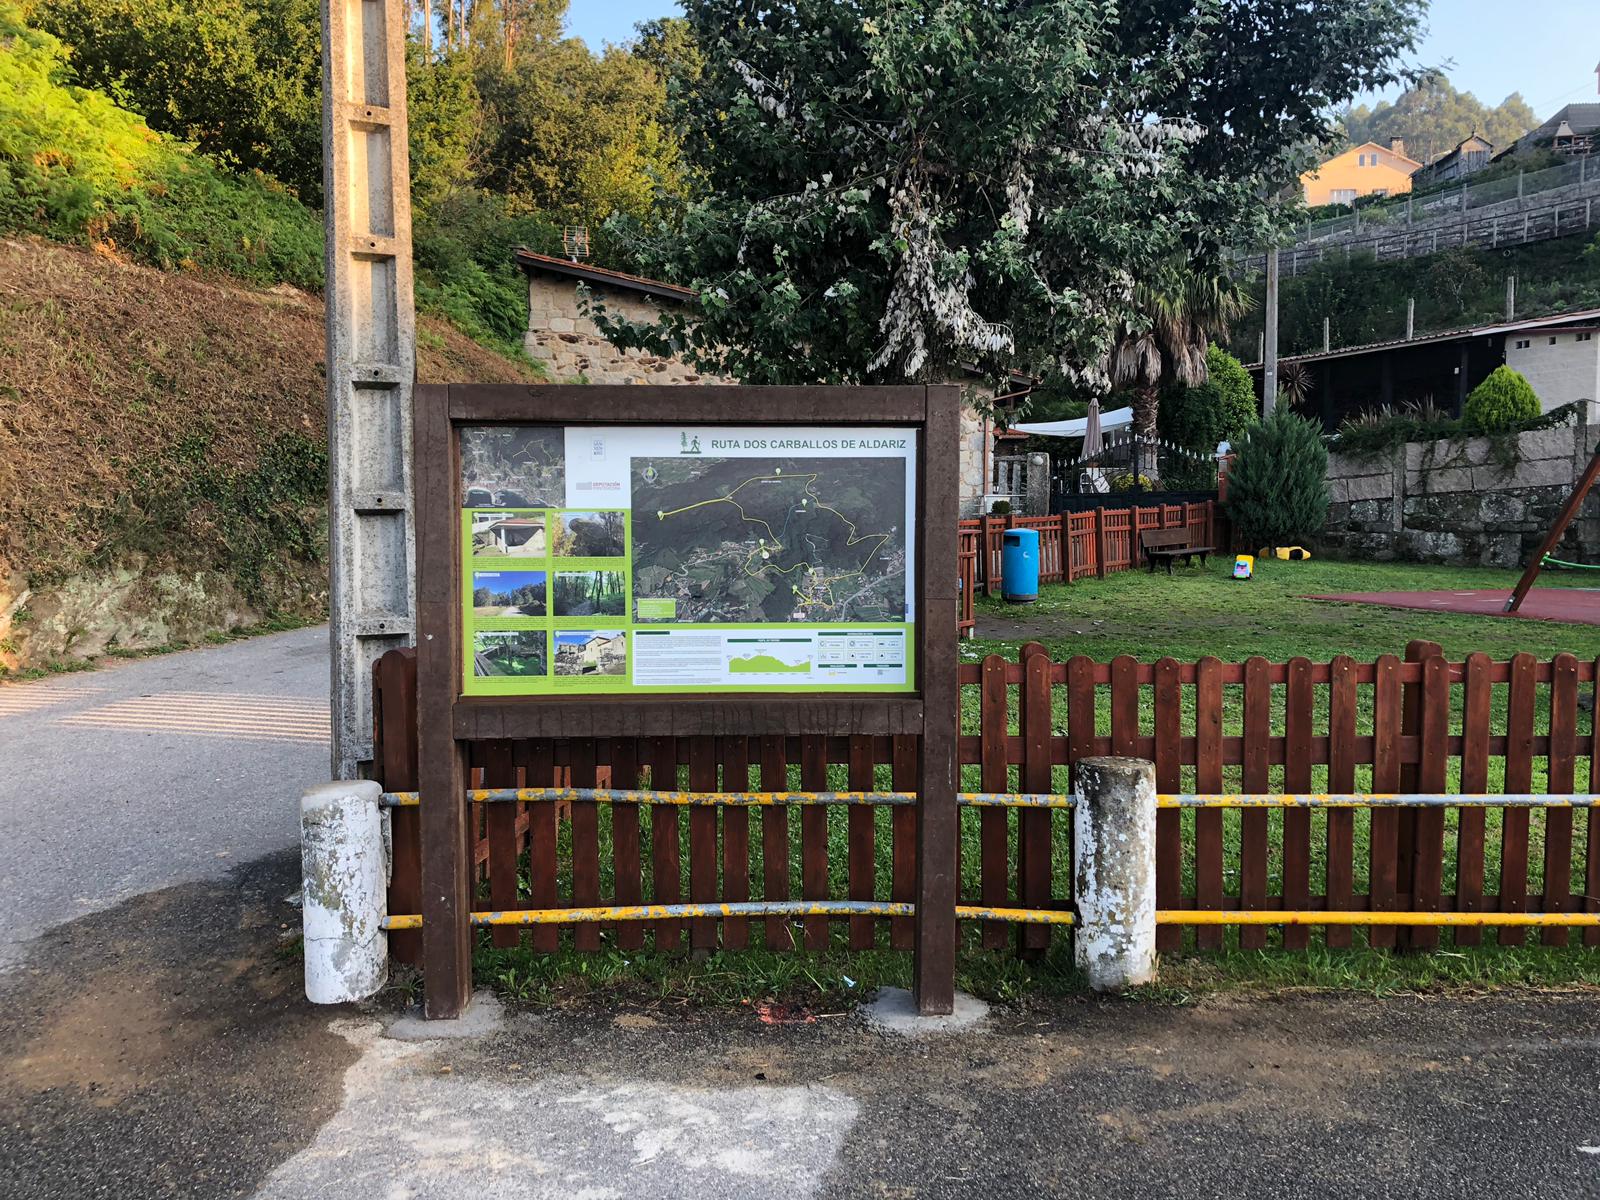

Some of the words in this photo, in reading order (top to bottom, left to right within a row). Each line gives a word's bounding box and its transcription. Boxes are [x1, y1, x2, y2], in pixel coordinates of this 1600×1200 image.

[711, 439, 741, 449] RUTA
[743, 439, 767, 449] DOS
[770, 439, 838, 449] CARBALLOS
[841, 439, 856, 449] DE
[858, 439, 907, 449] ALDARIZ
